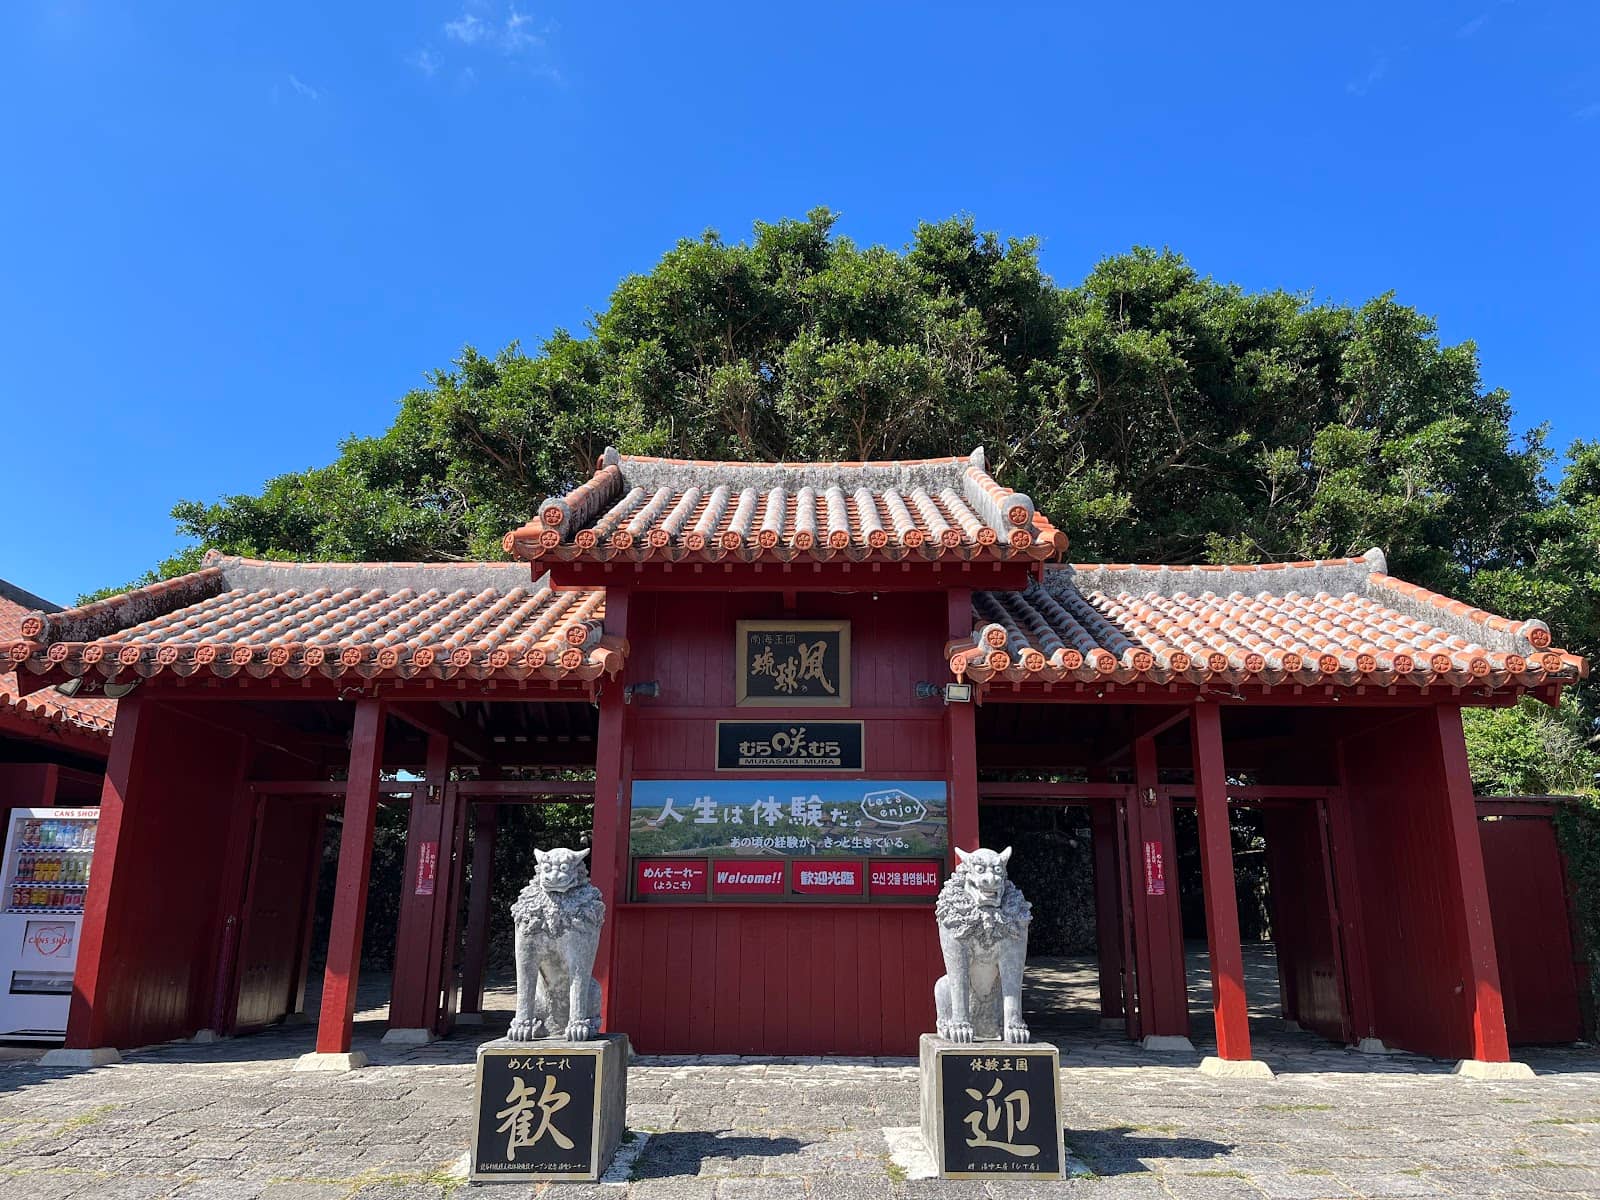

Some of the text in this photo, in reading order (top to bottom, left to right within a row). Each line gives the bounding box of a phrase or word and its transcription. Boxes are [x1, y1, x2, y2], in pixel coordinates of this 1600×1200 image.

[739, 727, 841, 757] むら咲むら
[867, 794, 902, 807] Let's
[656, 795, 862, 827] 人生は体験だ。
[880, 803, 920, 818] enjoy
[643, 868, 703, 878] めんそーれー
[717, 871, 782, 884] Welcome!!
[872, 872, 937, 886] 오신 것을 환영합니다
[52, 937, 73, 945] SHOP
[508, 1058, 571, 1071] めんそーれ
[970, 1058, 1028, 1072] 体験王国
[496, 1075, 574, 1161] 歓
[963, 1078, 1041, 1157] 迎
